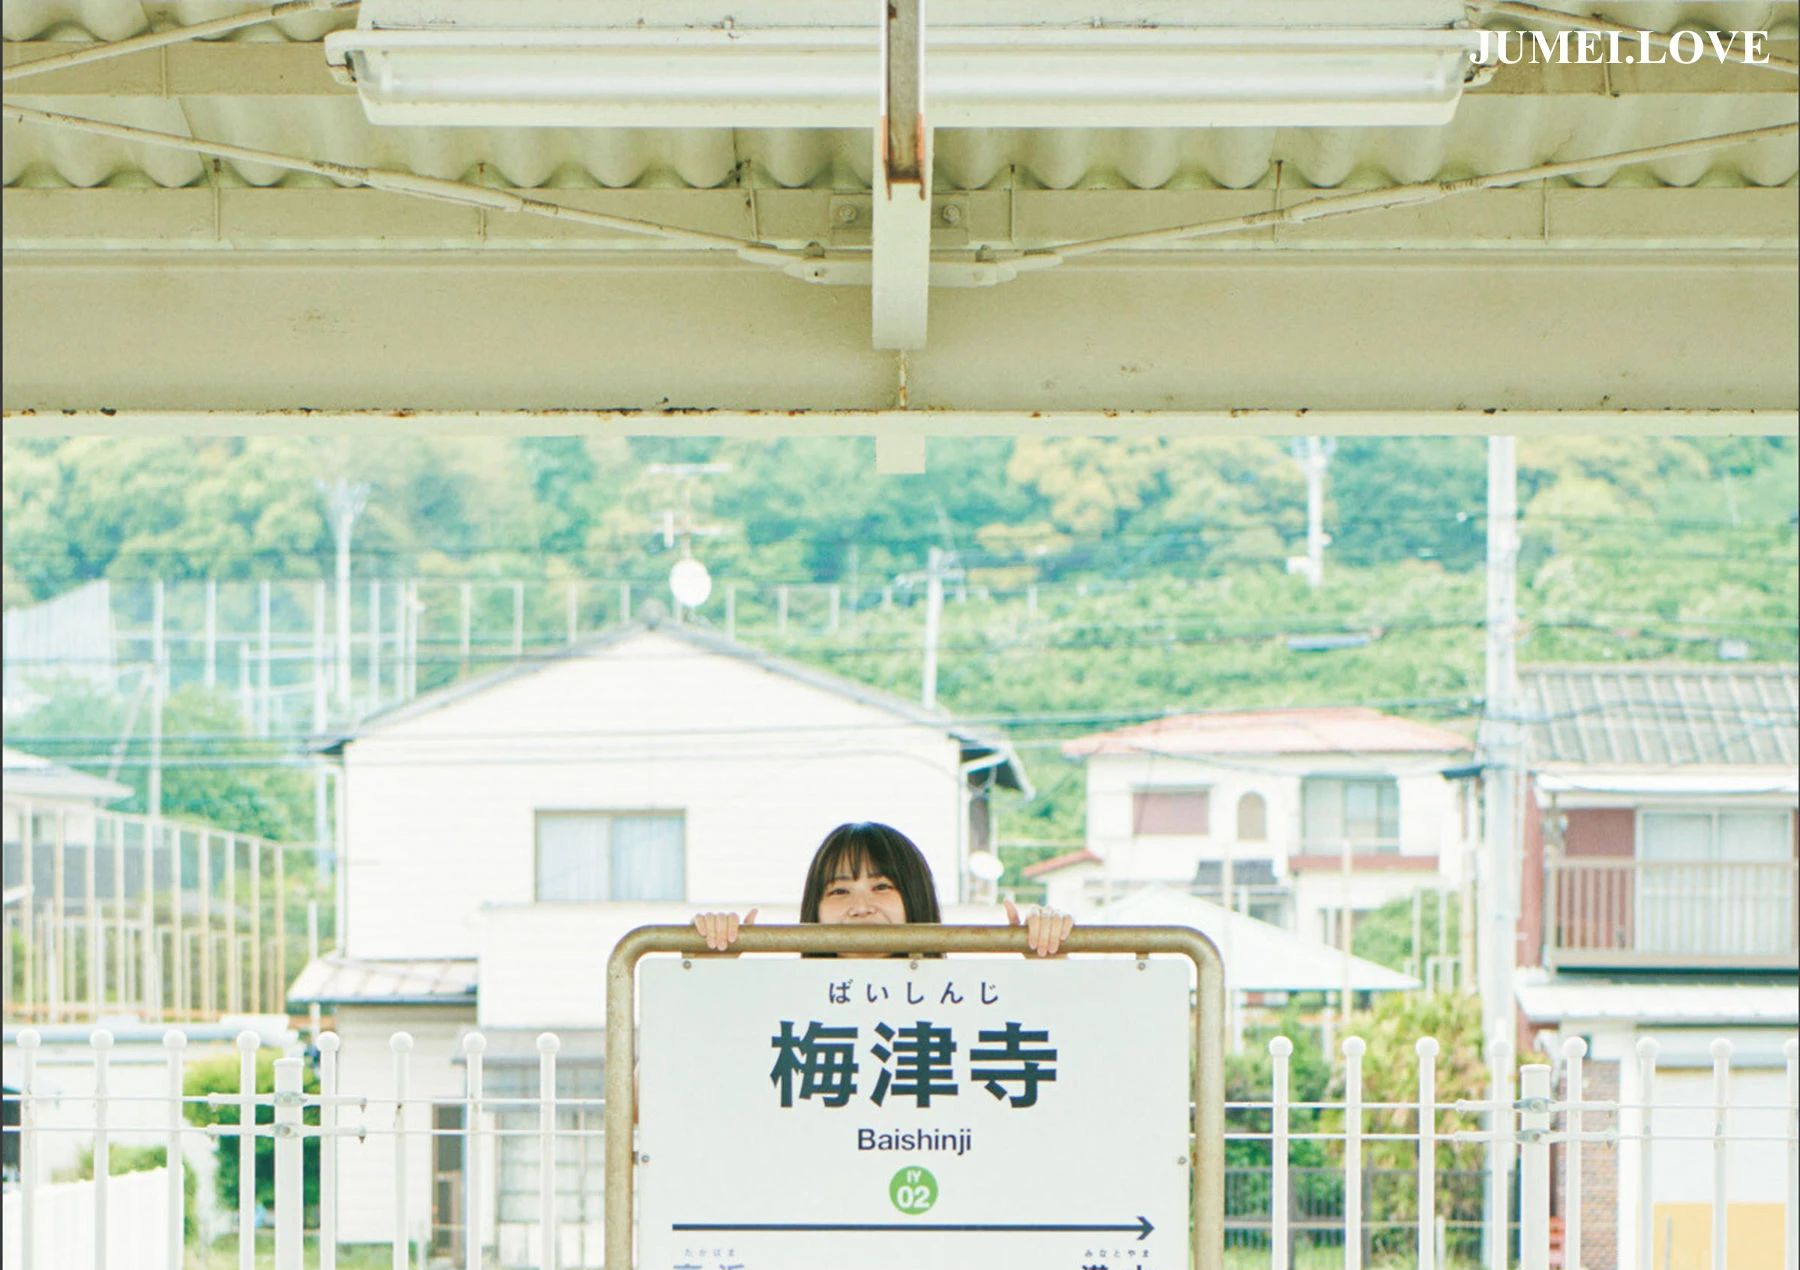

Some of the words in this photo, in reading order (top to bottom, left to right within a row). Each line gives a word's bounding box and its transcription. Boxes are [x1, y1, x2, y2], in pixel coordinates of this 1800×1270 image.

[829, 979, 999, 1005] ばいしんじ
[770, 1021, 1057, 1108] 梅津寺
[857, 1128, 971, 1156] Baishinji
[906, 1170, 922, 1183] IY
[897, 1185, 930, 1209] 02
